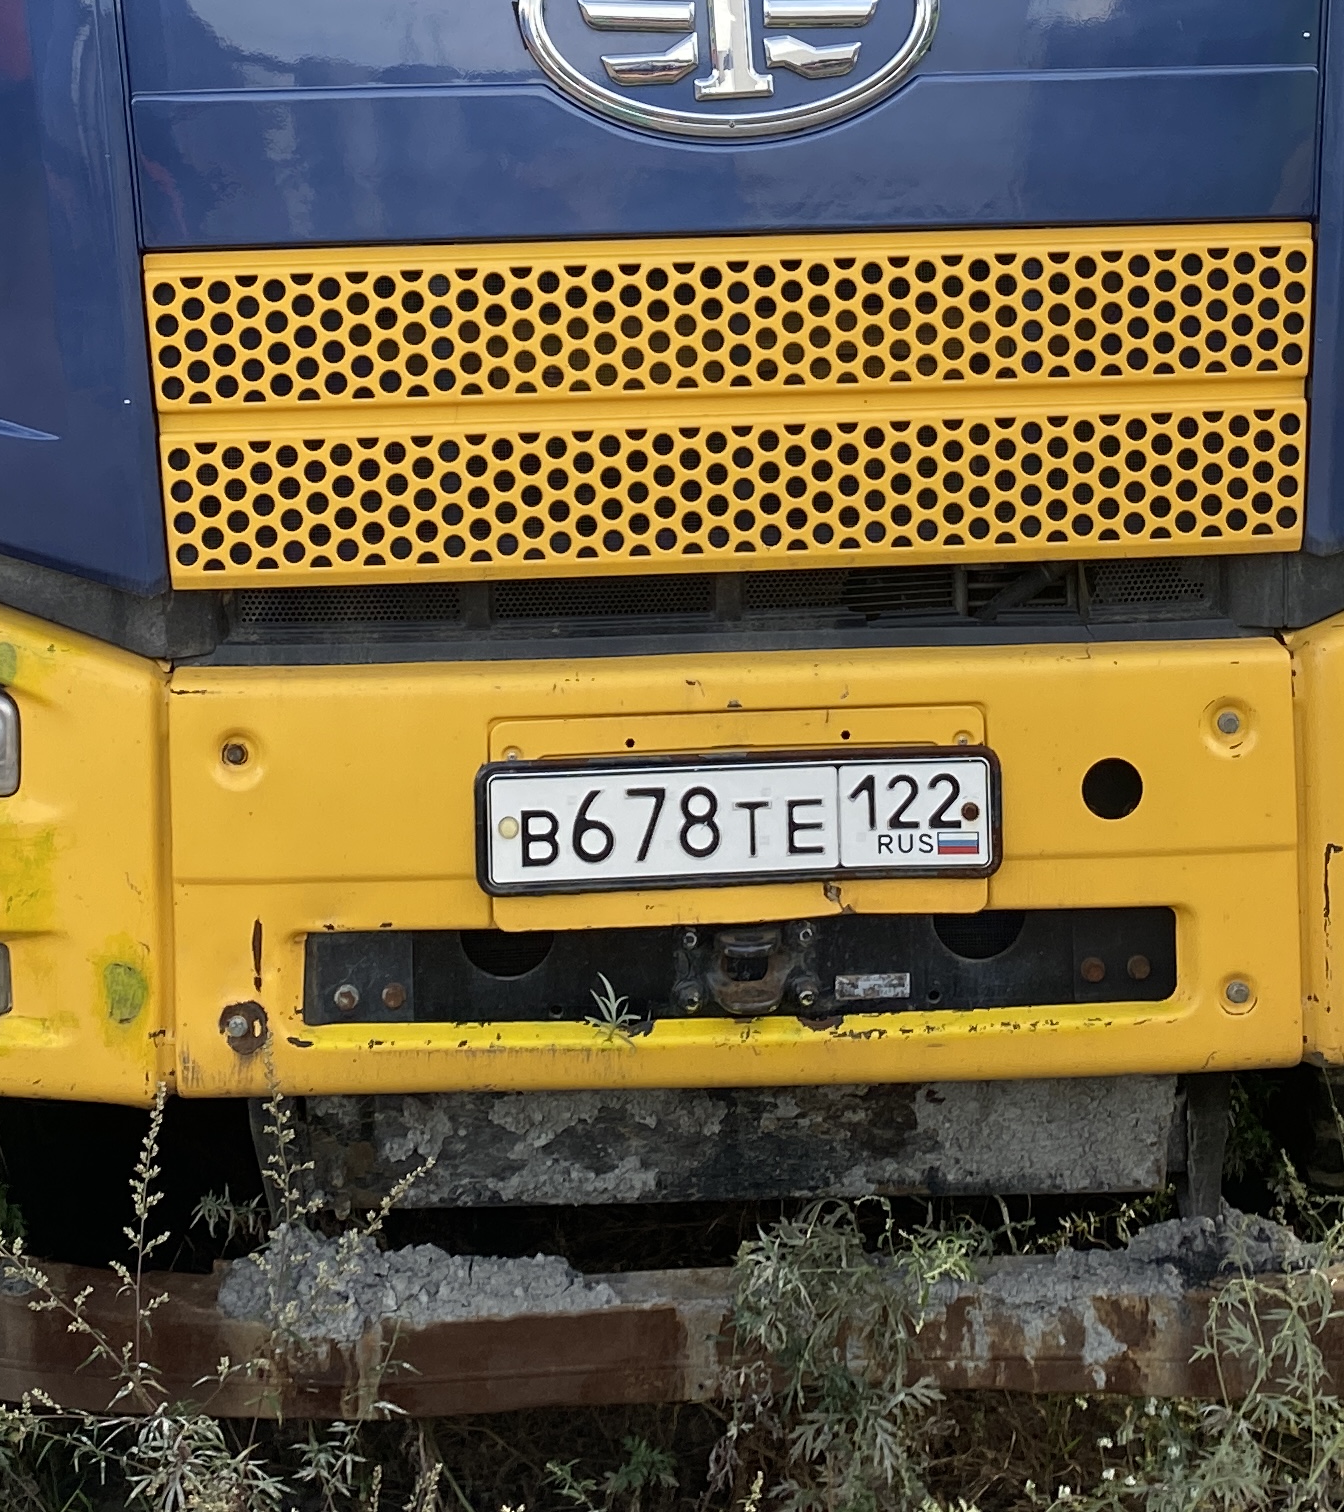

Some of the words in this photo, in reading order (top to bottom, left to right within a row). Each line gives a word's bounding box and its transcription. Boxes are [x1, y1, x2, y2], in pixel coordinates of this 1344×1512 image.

[520, 786, 826, 868] В678ТЕ
[847, 772, 963, 831] 122
[877, 833, 935, 854] RUS
